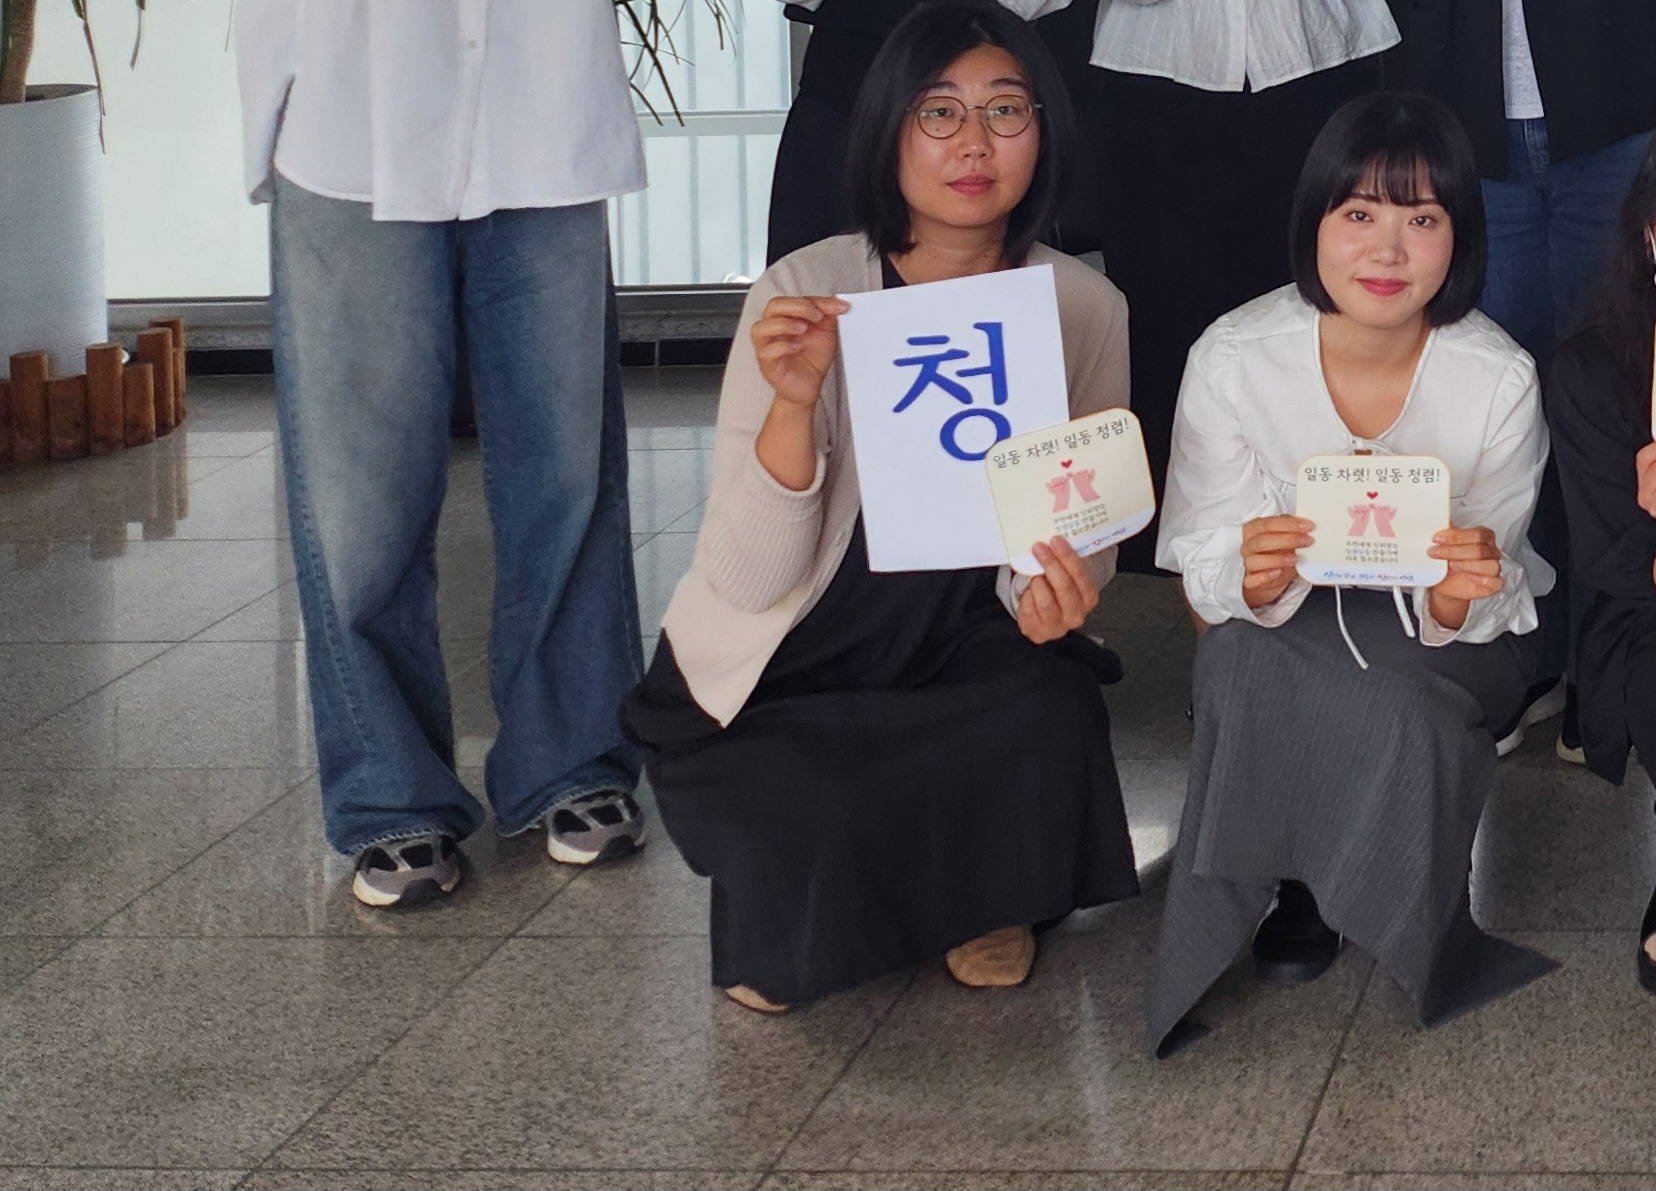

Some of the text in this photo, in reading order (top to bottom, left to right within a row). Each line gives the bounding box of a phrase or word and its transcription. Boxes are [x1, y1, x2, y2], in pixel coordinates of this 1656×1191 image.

[893, 323, 1011, 461] 청
[993, 418, 1129, 469] 일동 차렷! 일동 청렴!
[1305, 467, 1439, 484] 일동 차렷! 일동 청렴!
